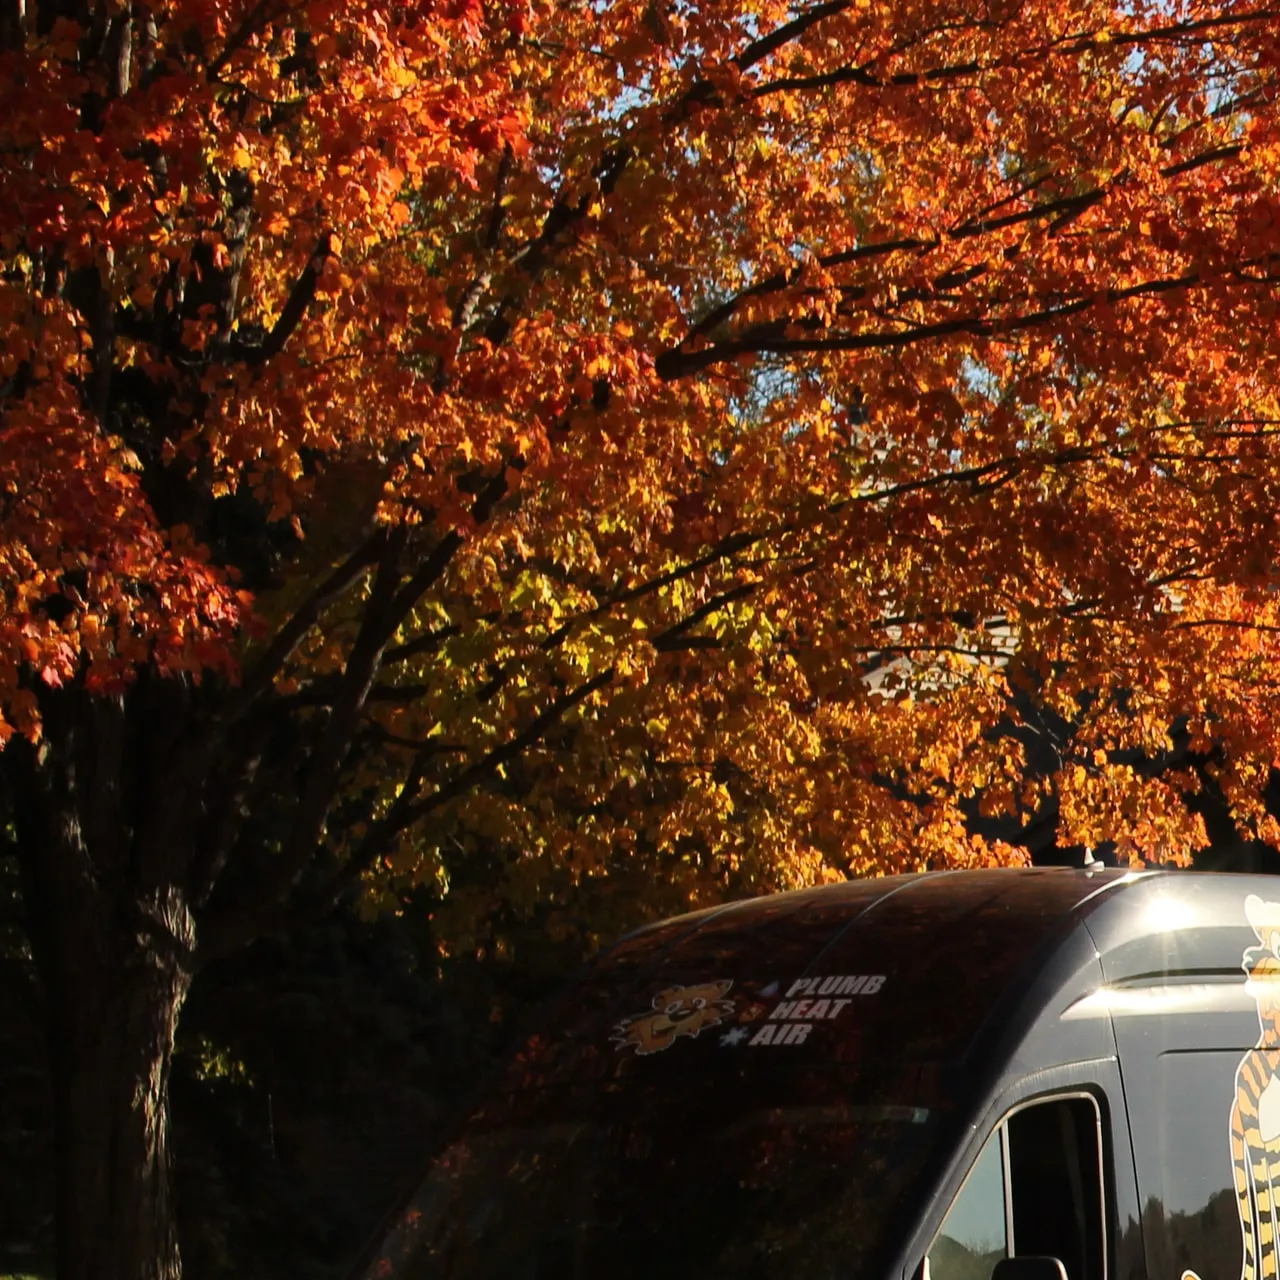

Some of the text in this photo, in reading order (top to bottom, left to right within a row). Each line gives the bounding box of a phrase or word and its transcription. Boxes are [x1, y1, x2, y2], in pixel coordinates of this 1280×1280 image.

[785, 975, 887, 998] PLUMB
[769, 998, 852, 1020] HEAT
[748, 1023, 813, 1047] AIR
